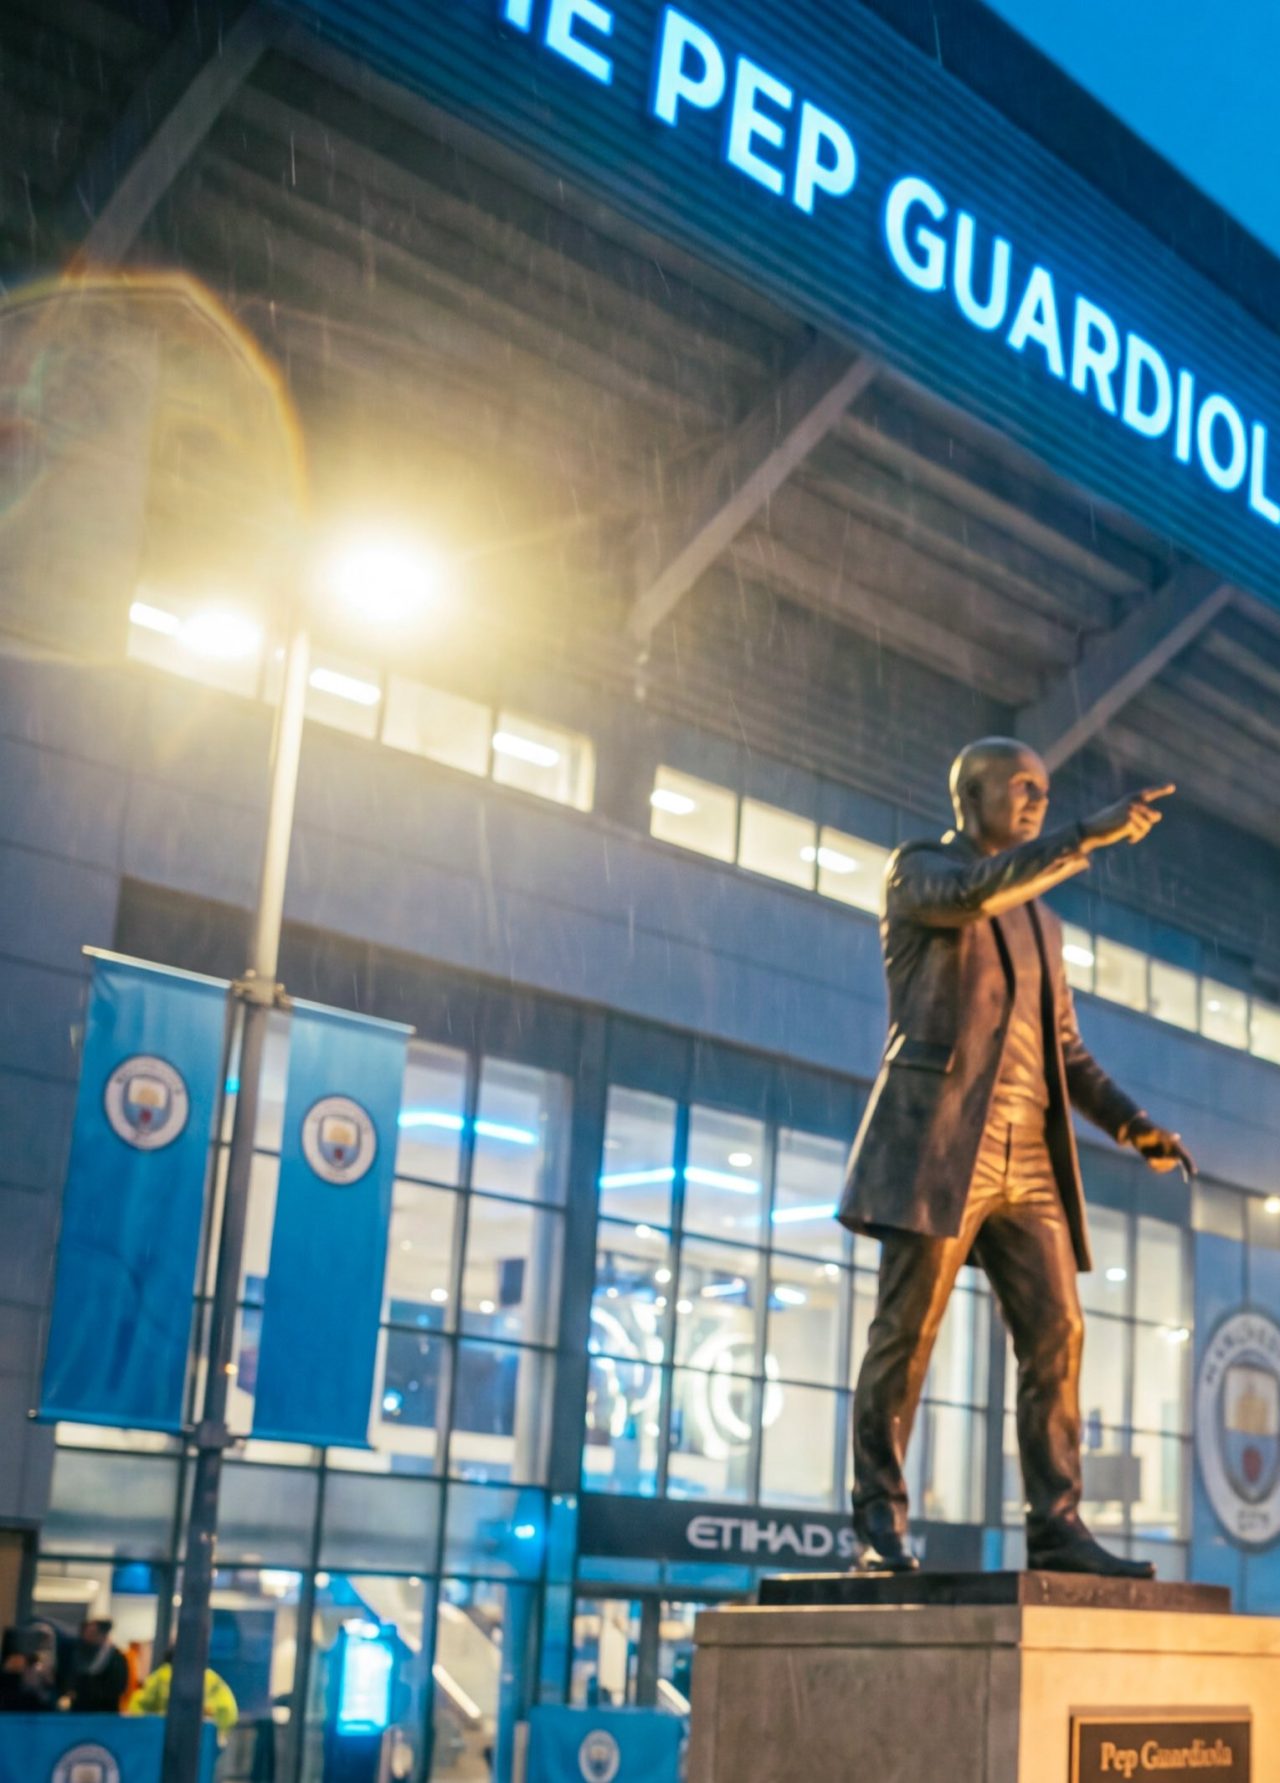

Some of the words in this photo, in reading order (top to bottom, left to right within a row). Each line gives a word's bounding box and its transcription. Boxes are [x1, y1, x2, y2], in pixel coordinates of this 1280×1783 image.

[504, 0, 612, 84] E
[653, 4, 856, 214] PEP
[686, 1516, 833, 1557] ETIHAD
[1100, 1741, 1138, 1778] Pep
